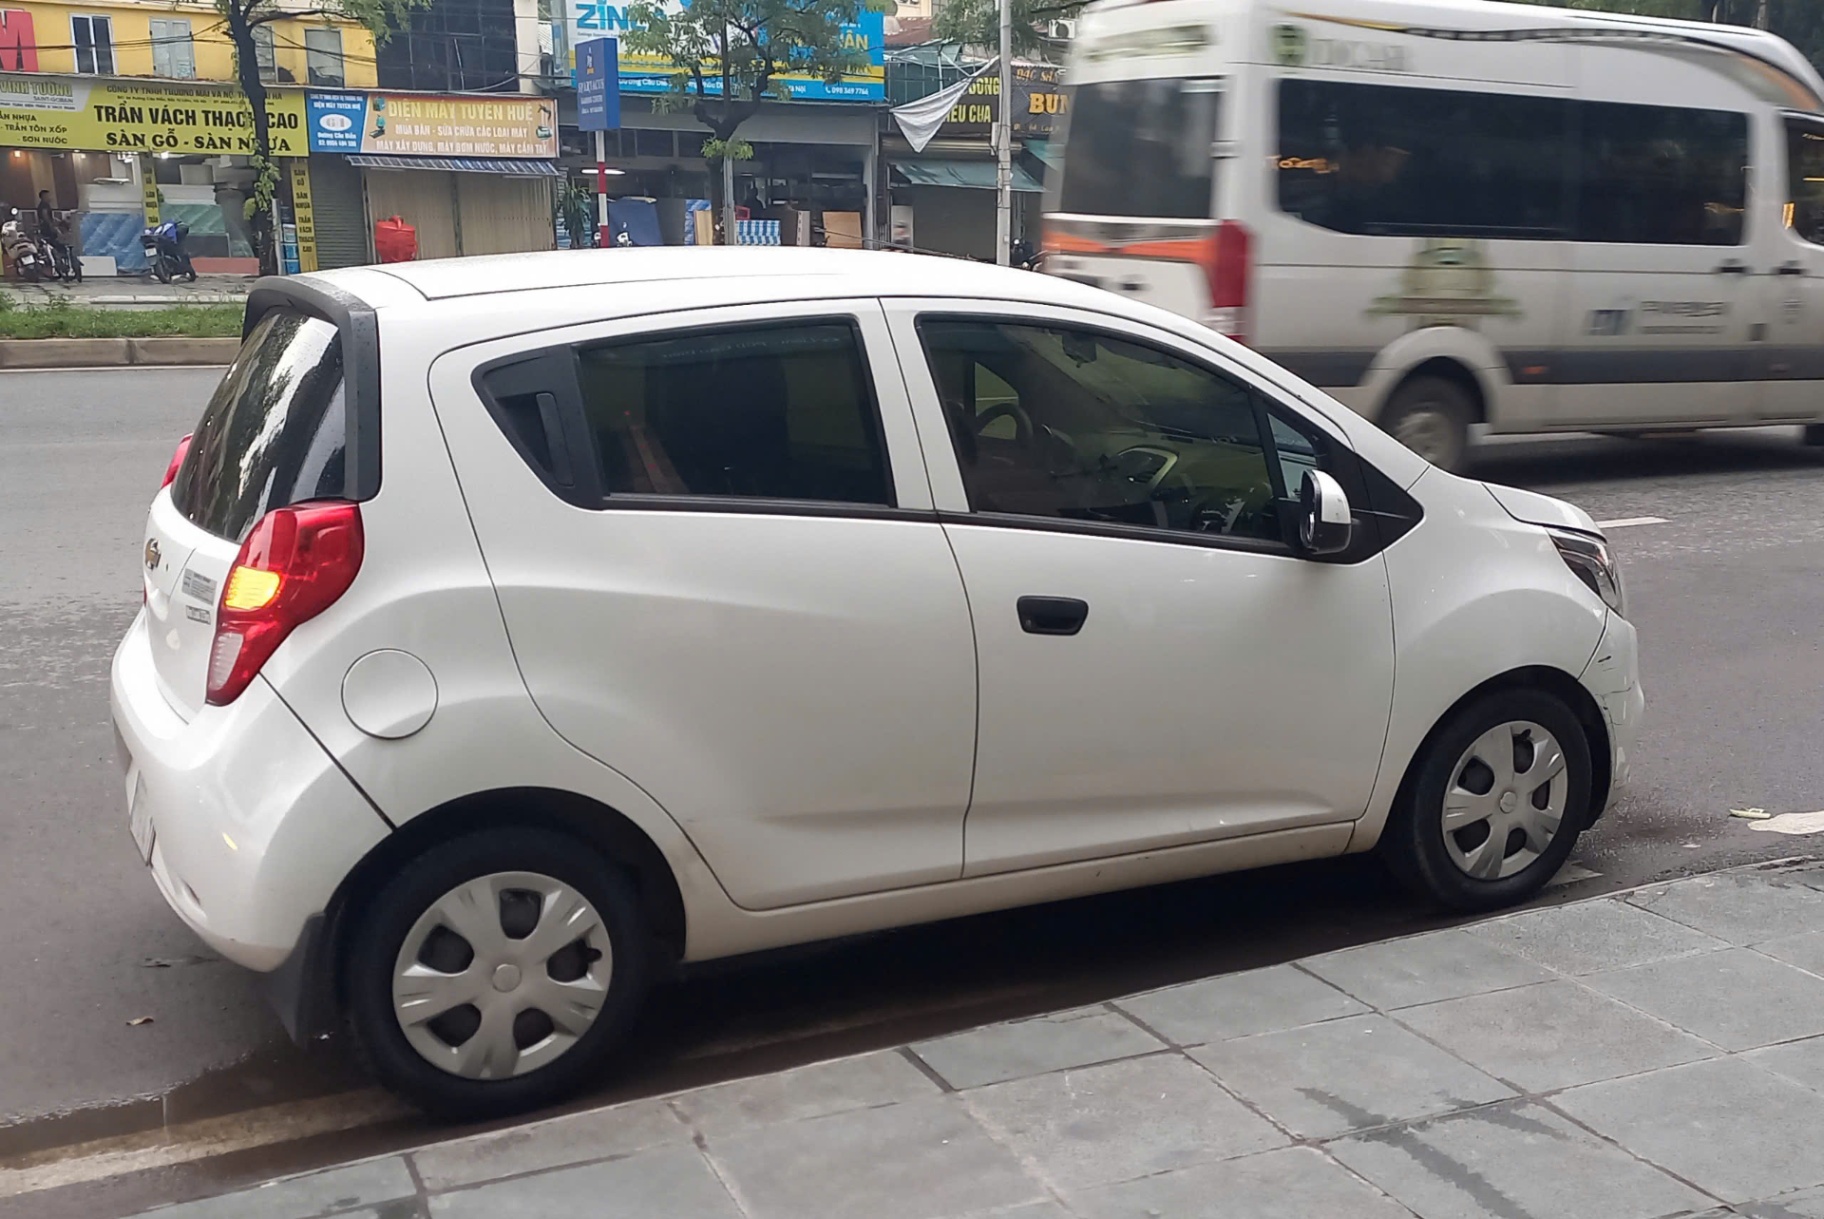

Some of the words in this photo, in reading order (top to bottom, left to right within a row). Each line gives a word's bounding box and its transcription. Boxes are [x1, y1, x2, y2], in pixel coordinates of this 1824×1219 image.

[93, 100, 144, 124] TRẦN
[148, 104, 197, 126] VÁCH
[266, 112, 298, 129] CAO
[388, 98, 421, 121] ĐIỆN
[425, 99, 455, 119] MÁY
[106, 128, 146, 147] SÀN
[151, 127, 179, 148] GỖ
[193, 132, 232, 150] SÀN
[237, 135, 292, 154] NỰA
